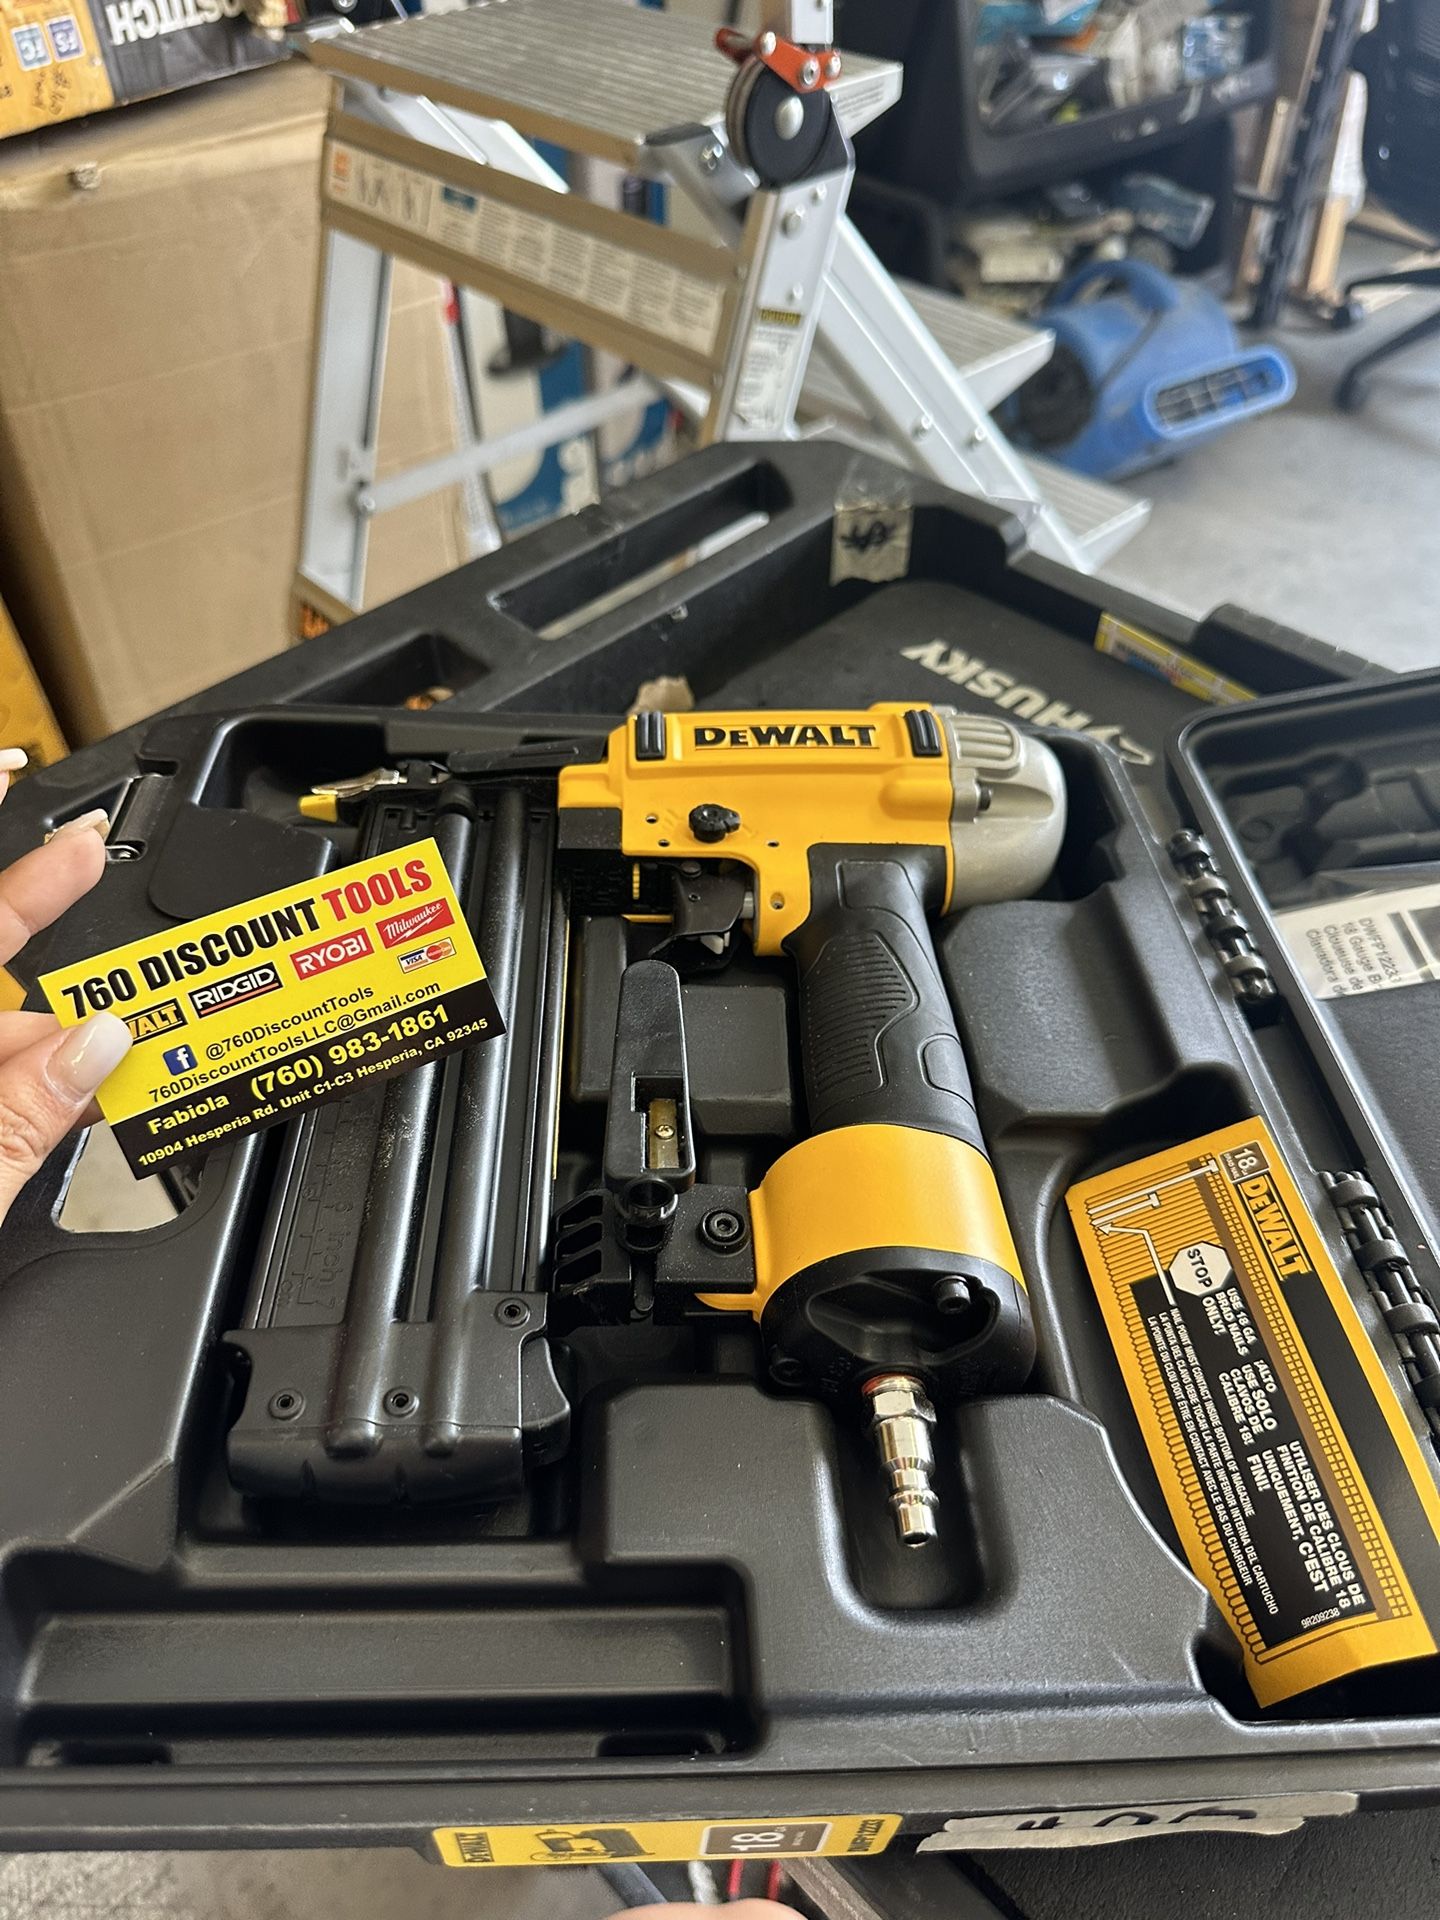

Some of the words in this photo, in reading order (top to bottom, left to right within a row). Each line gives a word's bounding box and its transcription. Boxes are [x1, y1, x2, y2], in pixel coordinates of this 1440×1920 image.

[900, 637, 1093, 732] HUSKY
[383, 903, 442, 939] Milwaukee
[62, 968, 137, 1019] 760
[138, 898, 320, 991] DISCOUNT
[321, 859, 432, 921] TOOLS
[296, 934, 367, 974] RYOBI
[1305, 928, 1339, 983] Clavadora
[1349, 935, 1374, 972] Gauge
[406, 955, 423, 965] VISA
[1323, 924, 1356, 975] Cloueuse
[1348, 976, 1364, 991] de
[192, 968, 275, 1009] RIDGID
[206, 985, 374, 1061] @760DiscountTools
[149, 982, 441, 1103] 760DiscountToolsLLC@Gmail.com
[251, 1054, 324, 1101] (760)
[328, 1003, 449, 1066] 983-1861
[138, 1141, 184, 1166] 10904
[185, 1114, 251, 1148] Hesperia
[253, 1104, 278, 1121] Rd.
[280, 1087, 312, 1109] Unit
[313, 1072, 354, 1095] C1-C3
[356, 1048, 423, 1079] Hesperia,
[424, 1036, 445, 1051] CA
[447, 1018, 488, 1042] 92345
[147, 1094, 230, 1135] Fabiola
[1234, 1148, 1257, 1170] 18
[1242, 1174, 1308, 1275] DEWALT
[1187, 1247, 1213, 1289] STOP
[1202, 1296, 1228, 1336] ONLY!
[1226, 1287, 1245, 1311] USE
[1147, 1316, 1158, 1327] LA
[1158, 1311, 1169, 1323] LA
[1162, 1321, 1178, 1346] PUNTA
[1170, 1307, 1183, 1326] NAIL
[1215, 1291, 1236, 1323] BRAD
[1227, 1322, 1249, 1356] NAILS
[1236, 1311, 1250, 1327] 18
[1151, 1325, 1168, 1352] POINTE
[1170, 1344, 1183, 1360] DEL
[1176, 1324, 1192, 1346] POINT
[1242, 1326, 1257, 1344] GA
[1159, 1350, 1171, 1363] DU
[1163, 1362, 1179, 1383] CLOU
[1175, 1359, 1192, 1384] CLAVO
[1183, 1345, 1200, 1367] MUST
[1170, 1381, 1186, 1400] DOIT
[1184, 1383, 1201, 1406] DEBE
[1191, 1366, 1213, 1400] CONTACT
[1241, 1363, 1260, 1390] USE
[1251, 1389, 1278, 1431] SOLO
[1192, 1403, 1209, 1431] TOCAR
[1204, 1400, 1222, 1428] INSIDE
[1218, 1372, 1247, 1424] CALIBRE
[1238, 1425, 1255, 1446] 18!
[1230, 1368, 1256, 1415] CLAVOS
[1247, 1415, 1265, 1435] DE
[1184, 1420, 1196, 1433] EN
[1201, 1429, 1213, 1443] LA
[1213, 1426, 1234, 1461] BOTTOM
[1188, 1431, 1210, 1469] CONTACT
[1205, 1441, 1224, 1469] PARTE
[1226, 1460, 1239, 1472] OF
[1201, 1469, 1218, 1492] AVEC
[1215, 1467, 1237, 1508] INFERIOR
[1246, 1454, 1272, 1492] FINI!
[1210, 1491, 1223, 1505] LE
[1230, 1472, 1256, 1518] MAGAZINE
[1214, 1503, 1229, 1523] BAS
[1222, 1522, 1234, 1537] DU
[1230, 1506, 1251, 1546] INTERNA
[1262, 1449, 1305, 1541] UNIQUEMENT,
[1298, 1541, 1330, 1592] C'EST
[1276, 1444, 1308, 1502] FINITION
[1299, 1502, 1317, 1524] DE
[1309, 1524, 1343, 1587] CALIBRE
[1335, 1589, 1352, 1609] 18
[1289, 1440, 1322, 1501] UTILISER
[1313, 1501, 1334, 1531] DES
[1326, 1532, 1356, 1582] CLOUS
[1347, 1582, 1367, 1606] DE
[1227, 1536, 1253, 1586] CHARGEUR
[1244, 1545, 1258, 1565] DEL
[1252, 1564, 1279, 1615] CARTUCHO
[1301, 1607, 1340, 1629] 9R209238
[731, 1831, 785, 1851] 18
